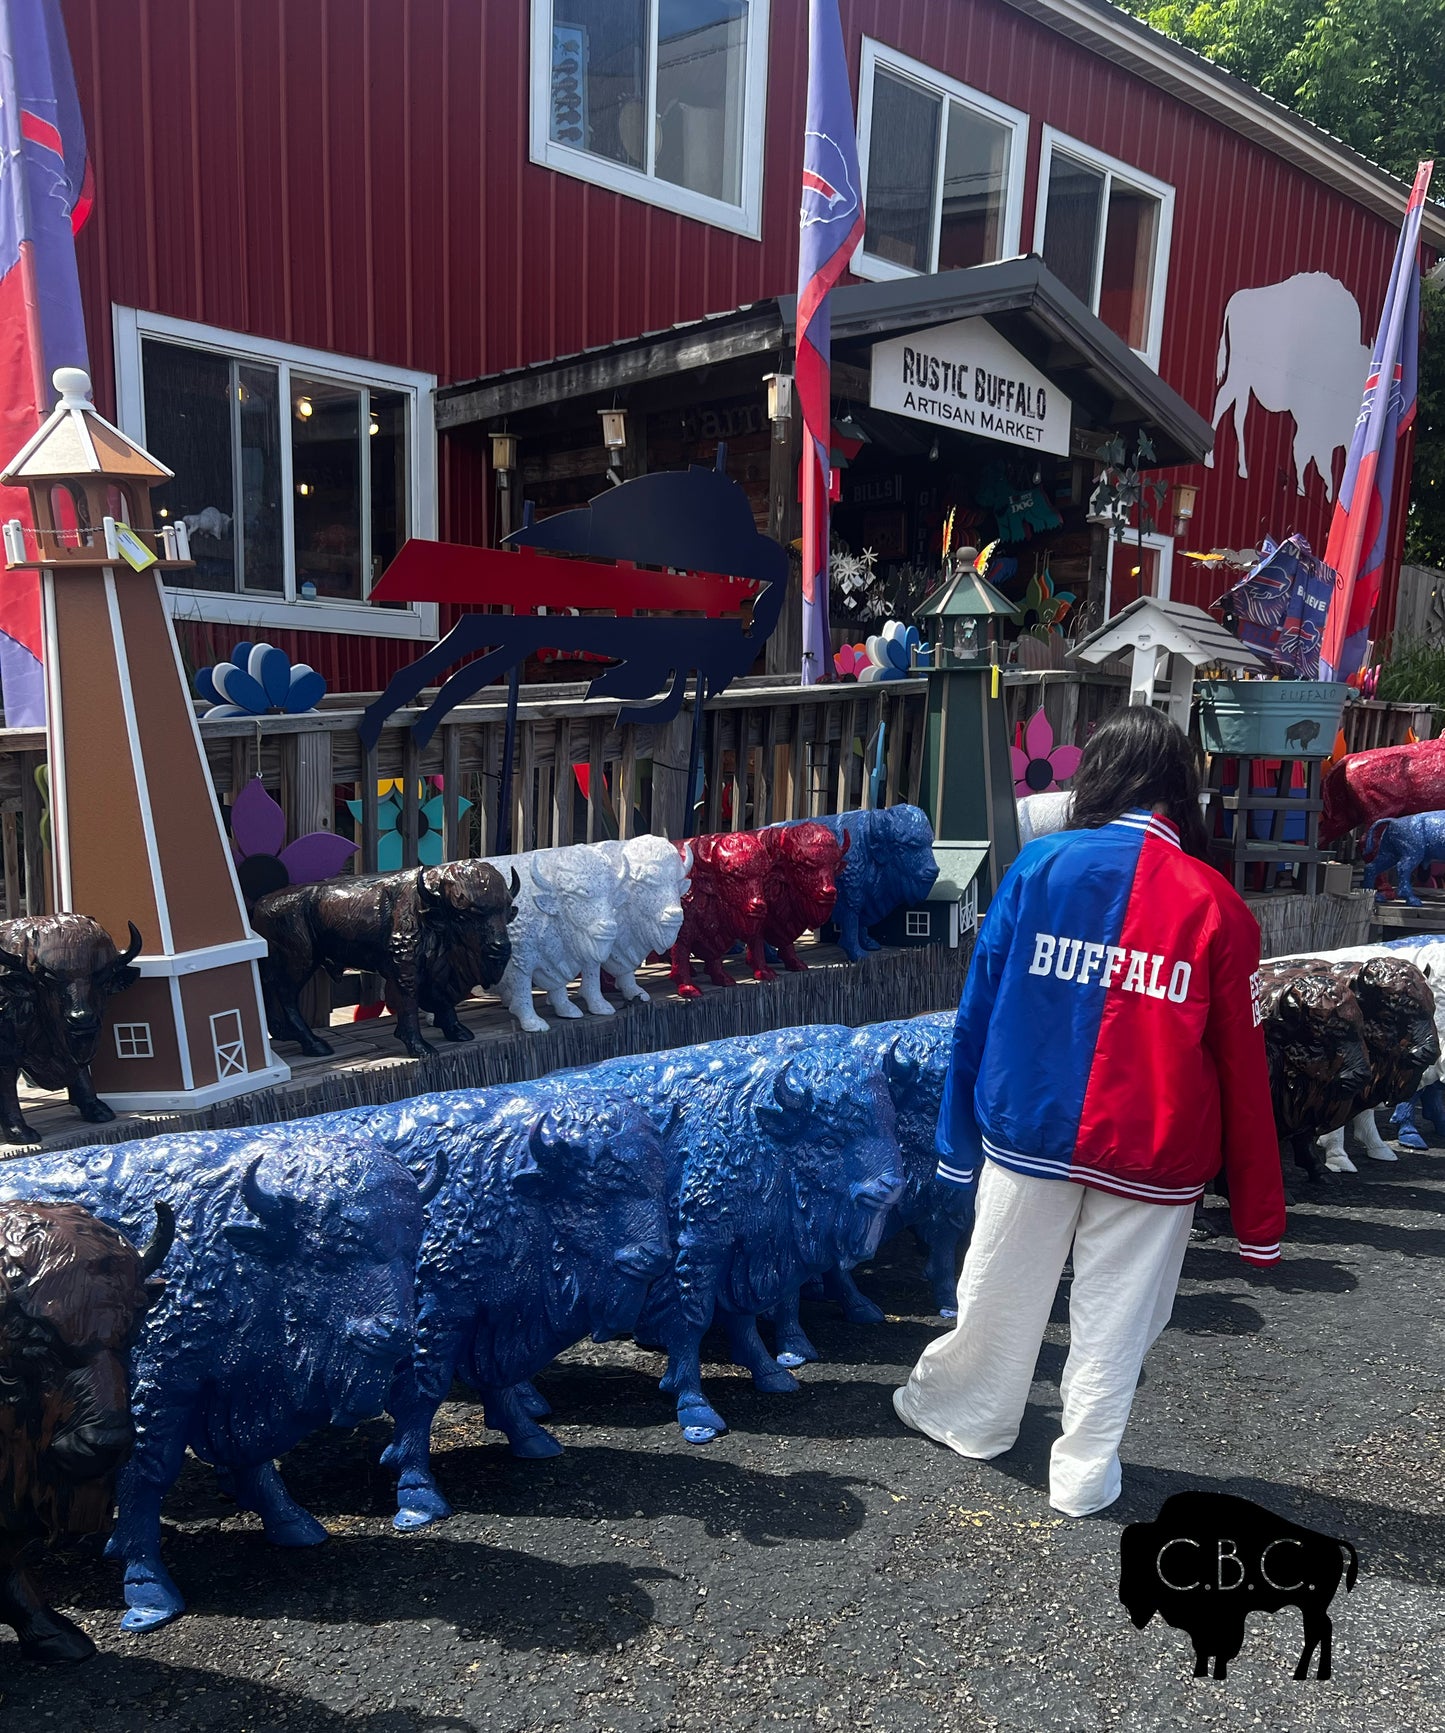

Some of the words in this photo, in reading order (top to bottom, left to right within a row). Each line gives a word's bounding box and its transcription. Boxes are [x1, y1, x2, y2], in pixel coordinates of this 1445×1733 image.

[903, 347, 968, 400] RUSTIC
[974, 367, 1046, 421] BUFFALO
[903, 391, 975, 425] ARTISAN
[980, 411, 1044, 443] MARKET
[853, 480, 893, 502] BILLS
[1011, 498, 1034, 513] DOG
[1297, 585, 1327, 612] BIEVE
[1280, 689, 1337, 702] BUFFALO
[1028, 933, 1192, 1003] BUFFALO
